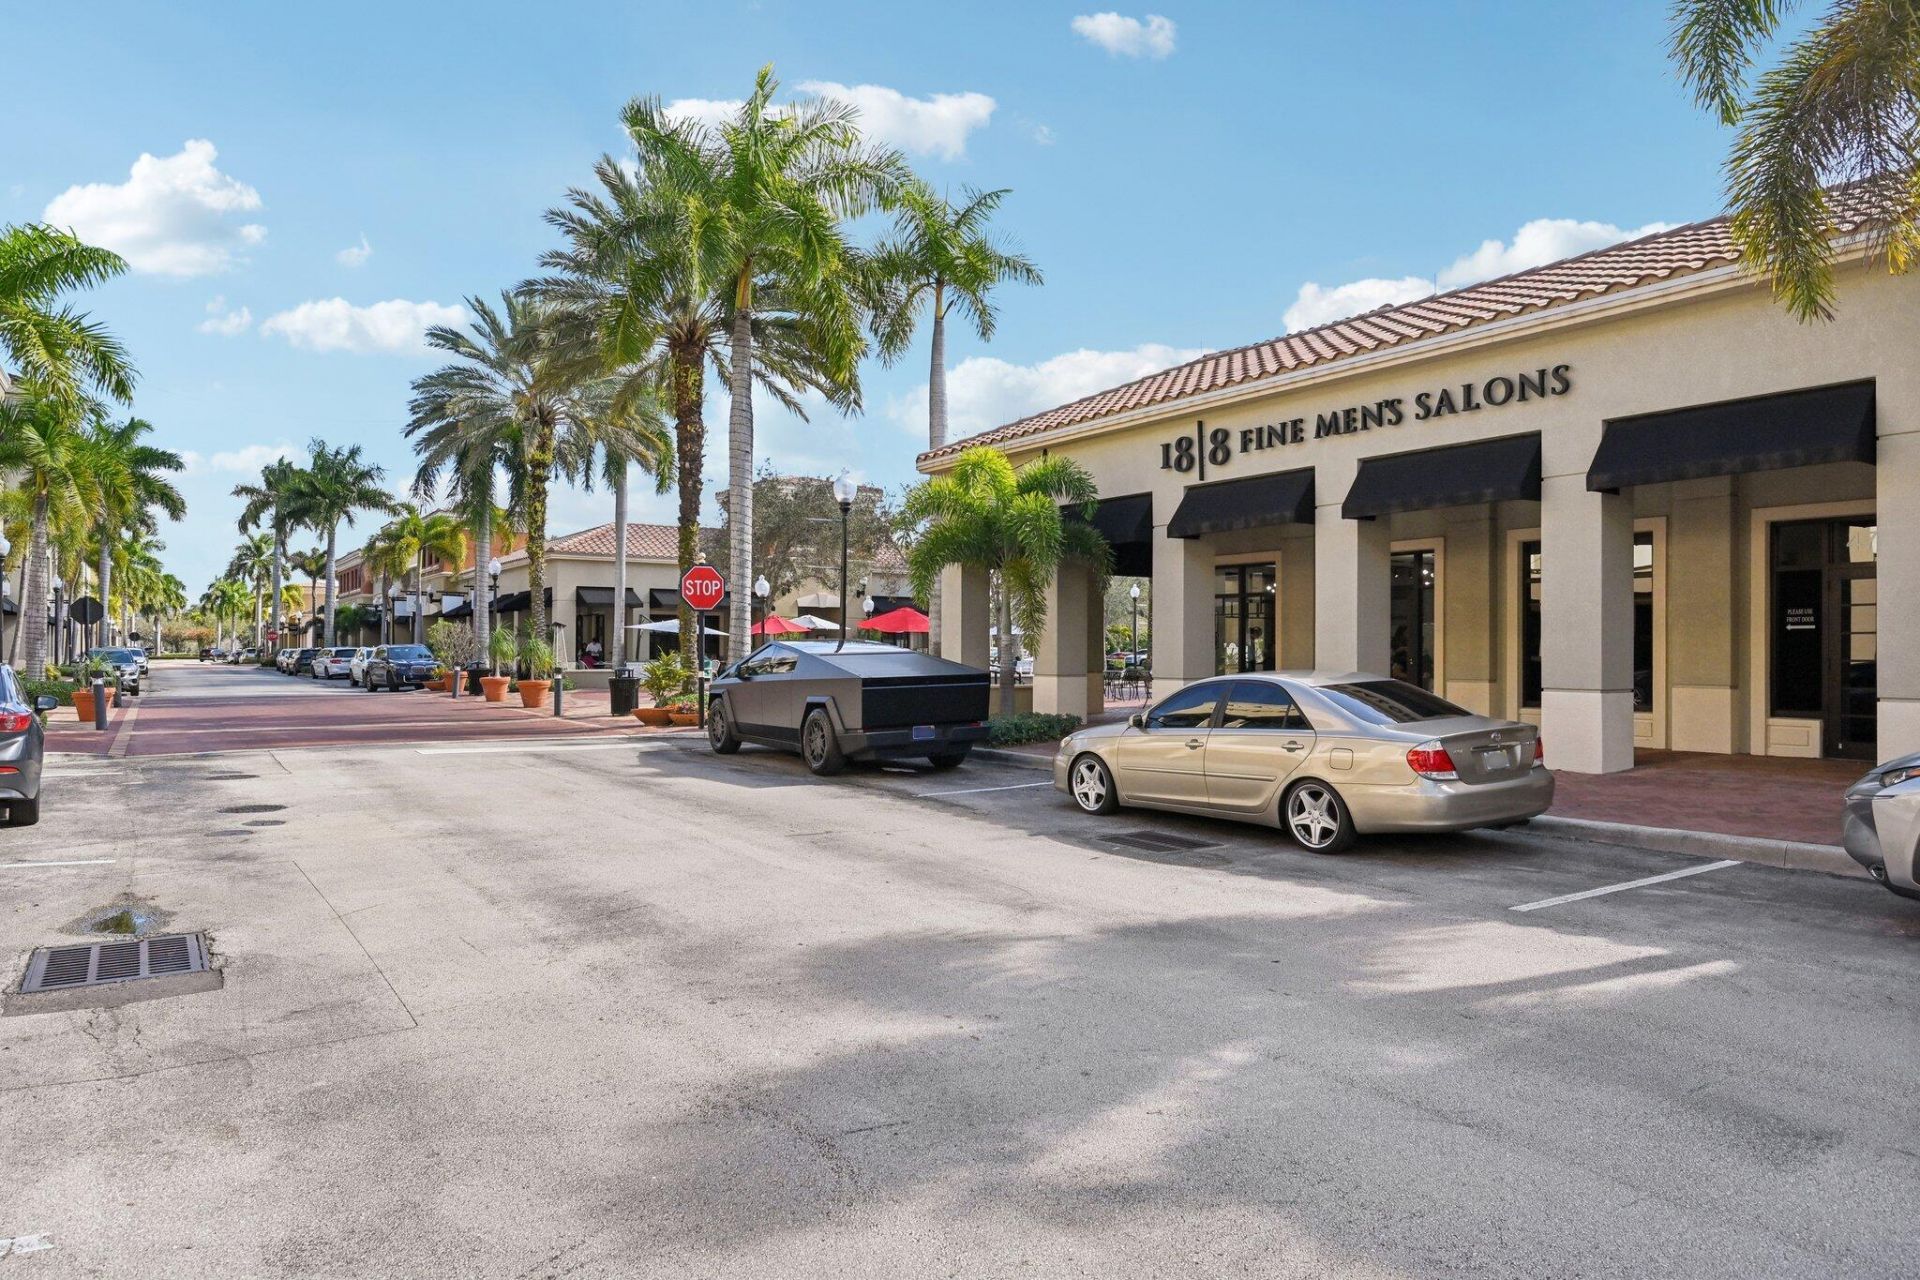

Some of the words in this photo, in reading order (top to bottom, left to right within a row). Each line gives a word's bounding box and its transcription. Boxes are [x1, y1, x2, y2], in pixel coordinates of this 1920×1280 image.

[1239, 418, 1304, 453] FINE
[1313, 399, 1403, 439] MEN'S
[1414, 364, 1570, 420] SALONS
[685, 579, 721, 596] STOP
